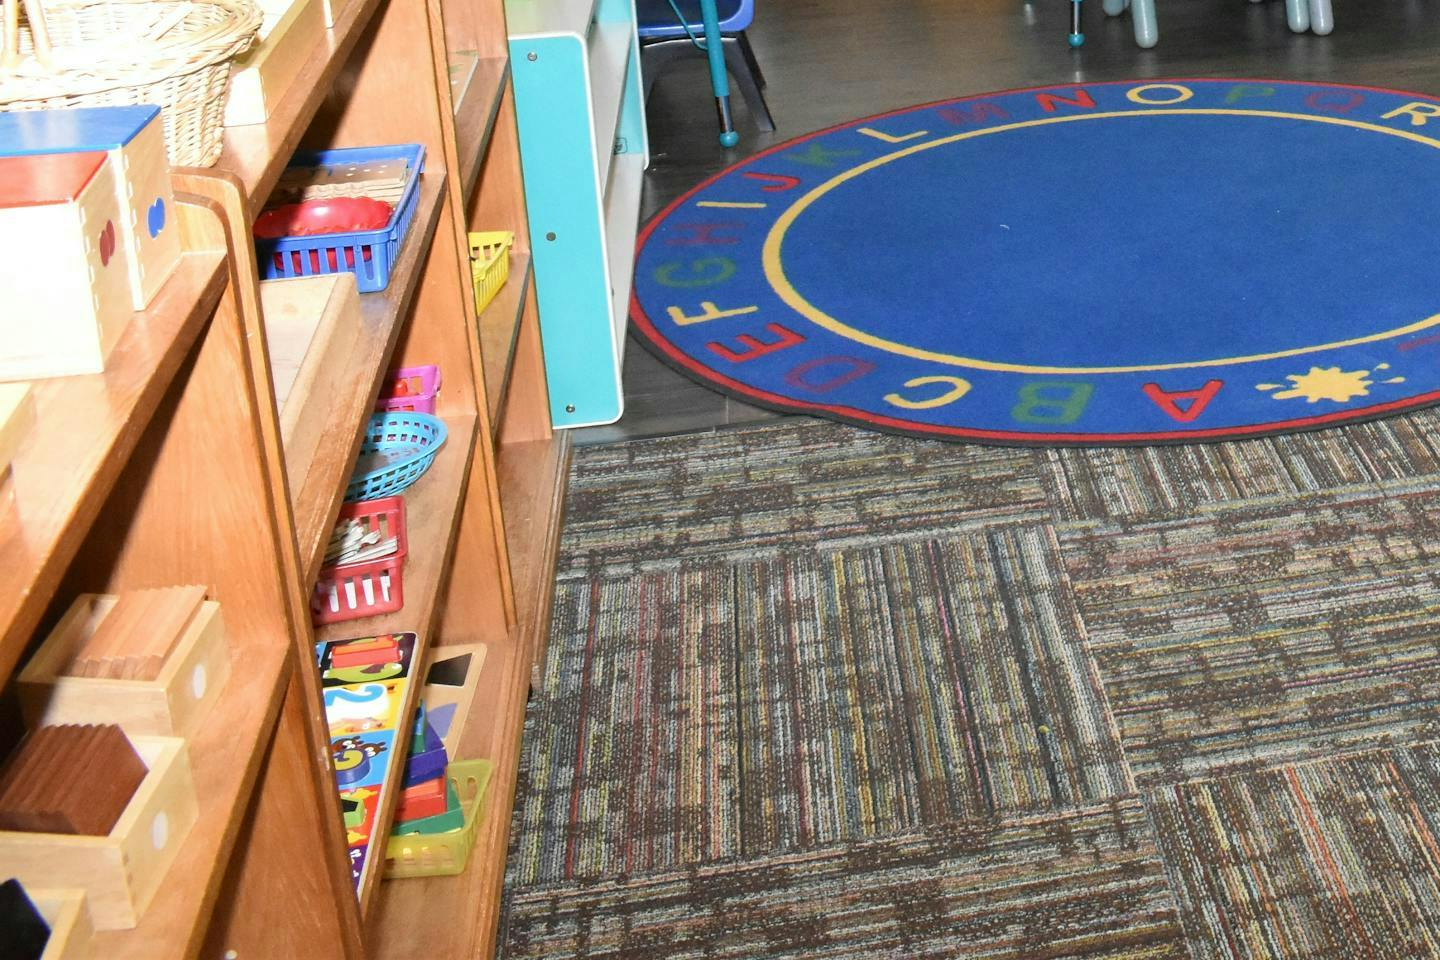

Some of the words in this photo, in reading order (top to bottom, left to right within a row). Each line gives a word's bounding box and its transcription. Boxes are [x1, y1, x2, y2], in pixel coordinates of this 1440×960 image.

[1035, 89, 1098, 112] N
[1126, 83, 1195, 105] O
[1222, 84, 1276, 104] P
[1303, 90, 1367, 114] Q
[937, 103, 1009, 126] M
[857, 127, 929, 144] L
[787, 142, 861, 167] K
[743, 171, 801, 193] J
[695, 200, 768, 209] I
[665, 222, 745, 246] H
[655, 256, 737, 289] G
[666, 301, 759, 327] F
[704, 322, 807, 363] E
[784, 355, 877, 394] D
[883, 375, 972, 410] C
[1010, 381, 1096, 425] B
[1142, 379, 1226, 423] A
